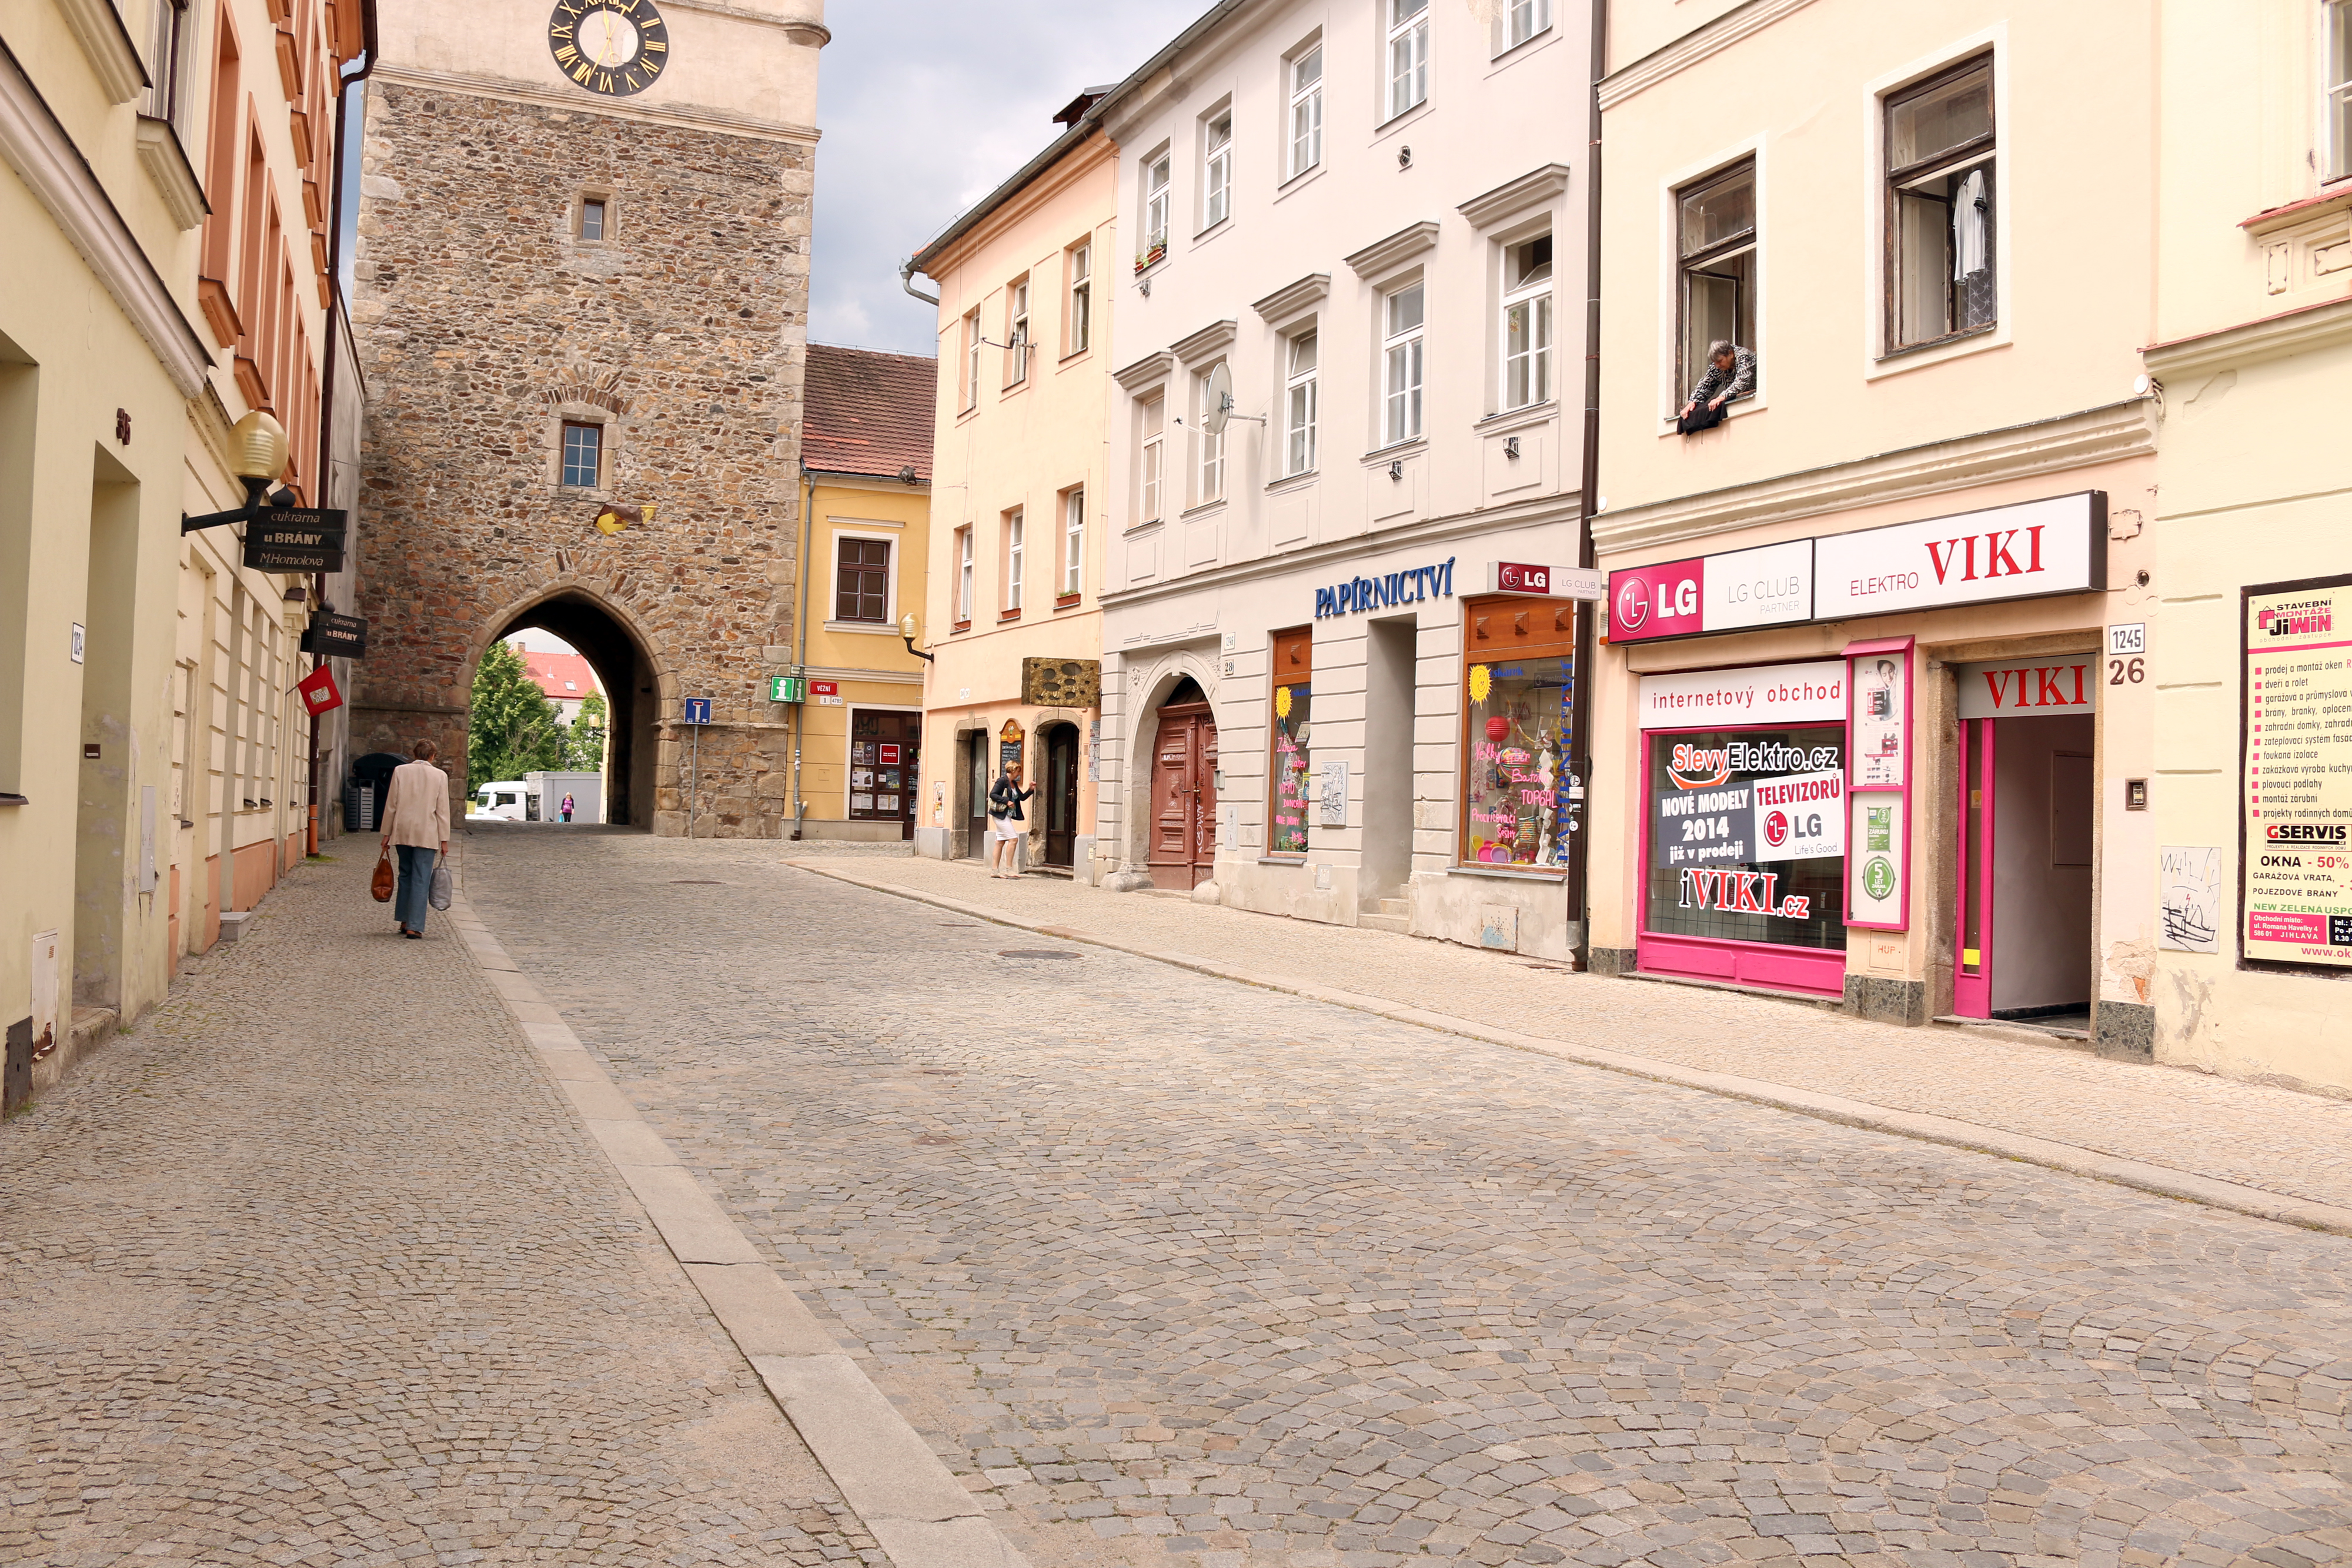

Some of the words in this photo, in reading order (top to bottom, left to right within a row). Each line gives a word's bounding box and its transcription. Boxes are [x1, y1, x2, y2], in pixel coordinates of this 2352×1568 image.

[271, 511, 320, 523] cukrárna
[275, 531, 322, 545] BRÁNY
[1925, 524, 2046, 586] VIKI
[1314, 556, 1456, 618] PAPÍRNICTVÍ
[1524, 571, 1546, 587] LG
[1562, 579, 1572, 587] LG
[1574, 580, 1596, 589] CLUB
[1850, 571, 1919, 596] ELEKTRO
[1658, 579, 1697, 618] LG
[1728, 584, 1748, 603] LG
[1754, 576, 1800, 600] CLUB
[2277, 597, 2332, 610] STAVEBNÍ
[1760, 600, 1800, 614] PARTNER
[2277, 607, 2331, 618] MONTÁŽE
[331, 617, 357, 628] cukrárna
[332, 630, 358, 641] BRÁNY
[2112, 628, 2141, 649] 1245
[1225, 661, 1232, 672] 28
[2109, 657, 2144, 685] 26
[2265, 664, 2288, 676] prodej
[2297, 661, 2323, 672] montáž
[2324, 660, 2343, 670] oken
[1982, 664, 2088, 708] VIKI
[2265, 678, 2283, 688] dveří
[2291, 677, 2308, 687] rolet
[1653, 685, 1754, 709] internetový
[1767, 680, 1840, 703] obchod
[2266, 692, 2297, 705] garážová
[2306, 688, 2347, 702] průmyslová
[2265, 707, 2287, 718] brány,
[2291, 706, 2318, 717] branky,
[2265, 721, 2295, 731] zahradní
[2297, 720, 2323, 731] domky,
[2264, 735, 2303, 747] zateplovací
[2305, 734, 2330, 746] systém
[1475, 741, 1501, 764] Velký
[1673, 743, 1837, 776] SlevyElektro.cz
[2263, 750, 2291, 760] foukaná
[2293, 749, 2318, 759] izolace
[2263, 764, 2298, 774] zakázková
[2301, 764, 2326, 775] výroba
[1757, 773, 1840, 806] TELEVIZORŮ
[2262, 778, 2291, 791] plovoucí
[2293, 778, 2323, 790] podlahy
[1662, 790, 1695, 817] NOVÉ
[1698, 788, 1749, 813] MODELY
[2262, 794, 2288, 803] montáž
[2290, 793, 2318, 803] zárubní
[2263, 808, 2292, 820] projekty
[2294, 808, 2330, 820] rodinných
[1682, 816, 1729, 841] 2014
[1794, 813, 1822, 838] LG
[2266, 825, 2347, 840] GSERVIS
[1669, 845, 1685, 864] již
[1686, 848, 1695, 859] v
[1698, 840, 1743, 862] prodeji
[1794, 844, 1815, 855] Life's
[1816, 842, 1838, 852] Good
[2260, 855, 2301, 867] OKNA
[2317, 856, 2350, 869] 50%
[1874, 863, 1883, 879] 5
[2253, 871, 2300, 881] GARÁŽOVÁ
[2303, 874, 2335, 882] VRATA,
[1679, 869, 1808, 918] iVIKI.cz
[2253, 888, 2303, 896] POJEZDOVÉ
[2307, 889, 2338, 898] BRÁNY
[2253, 902, 2277, 911] NEW
[2280, 904, 2323, 913] ZELENÁ
[2254, 914, 2283, 922] Obchodní
[2280, 931, 2318, 940] JIHLAVA
[2288, 925, 2313, 933] Havelky
[1877, 944, 1896, 954] HUP
